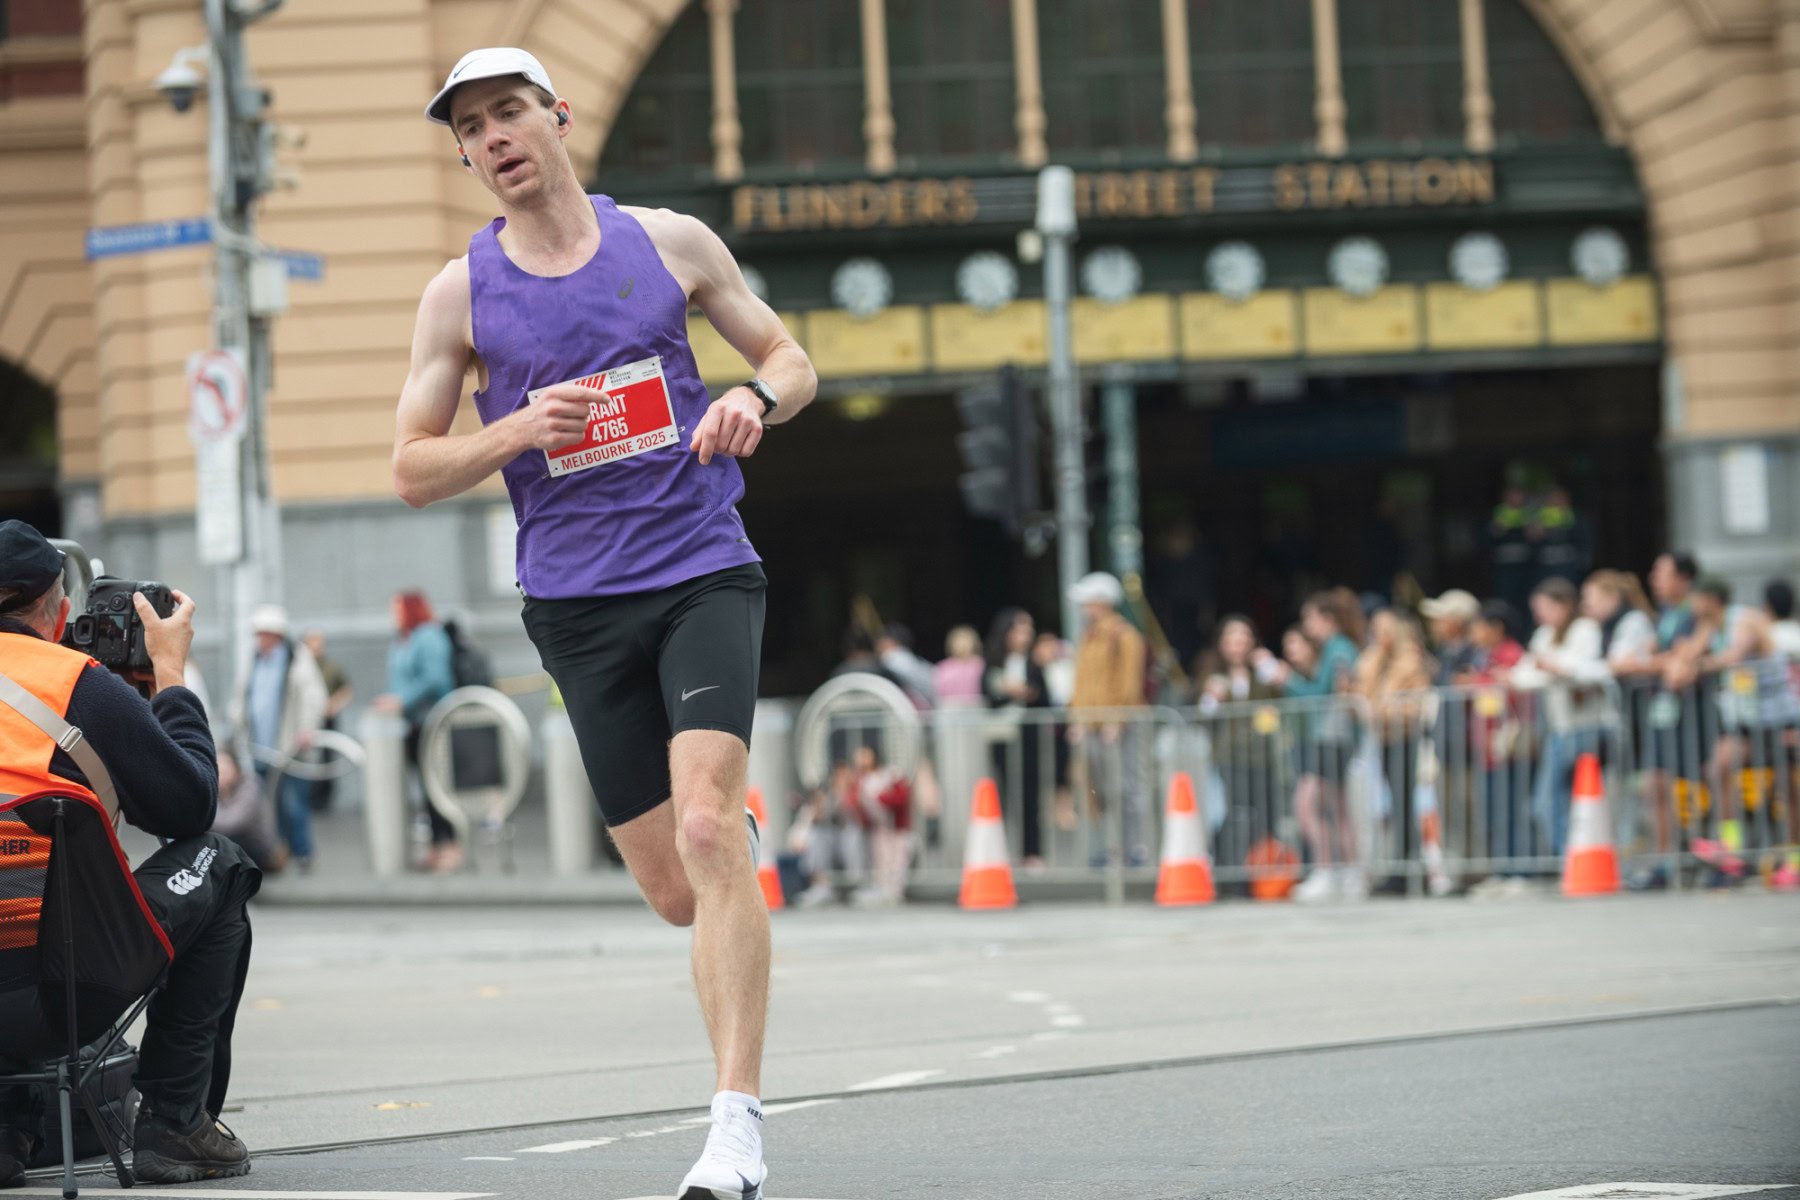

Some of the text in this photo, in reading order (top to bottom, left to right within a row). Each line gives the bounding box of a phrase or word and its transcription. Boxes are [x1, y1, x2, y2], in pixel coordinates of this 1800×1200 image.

[734, 158, 1494, 231] FLINDERS TREET STATION
[586, 393, 627, 422] RANT
[592, 417, 629, 442] 4765
[561, 431, 667, 471] MELBOURNE 2025
